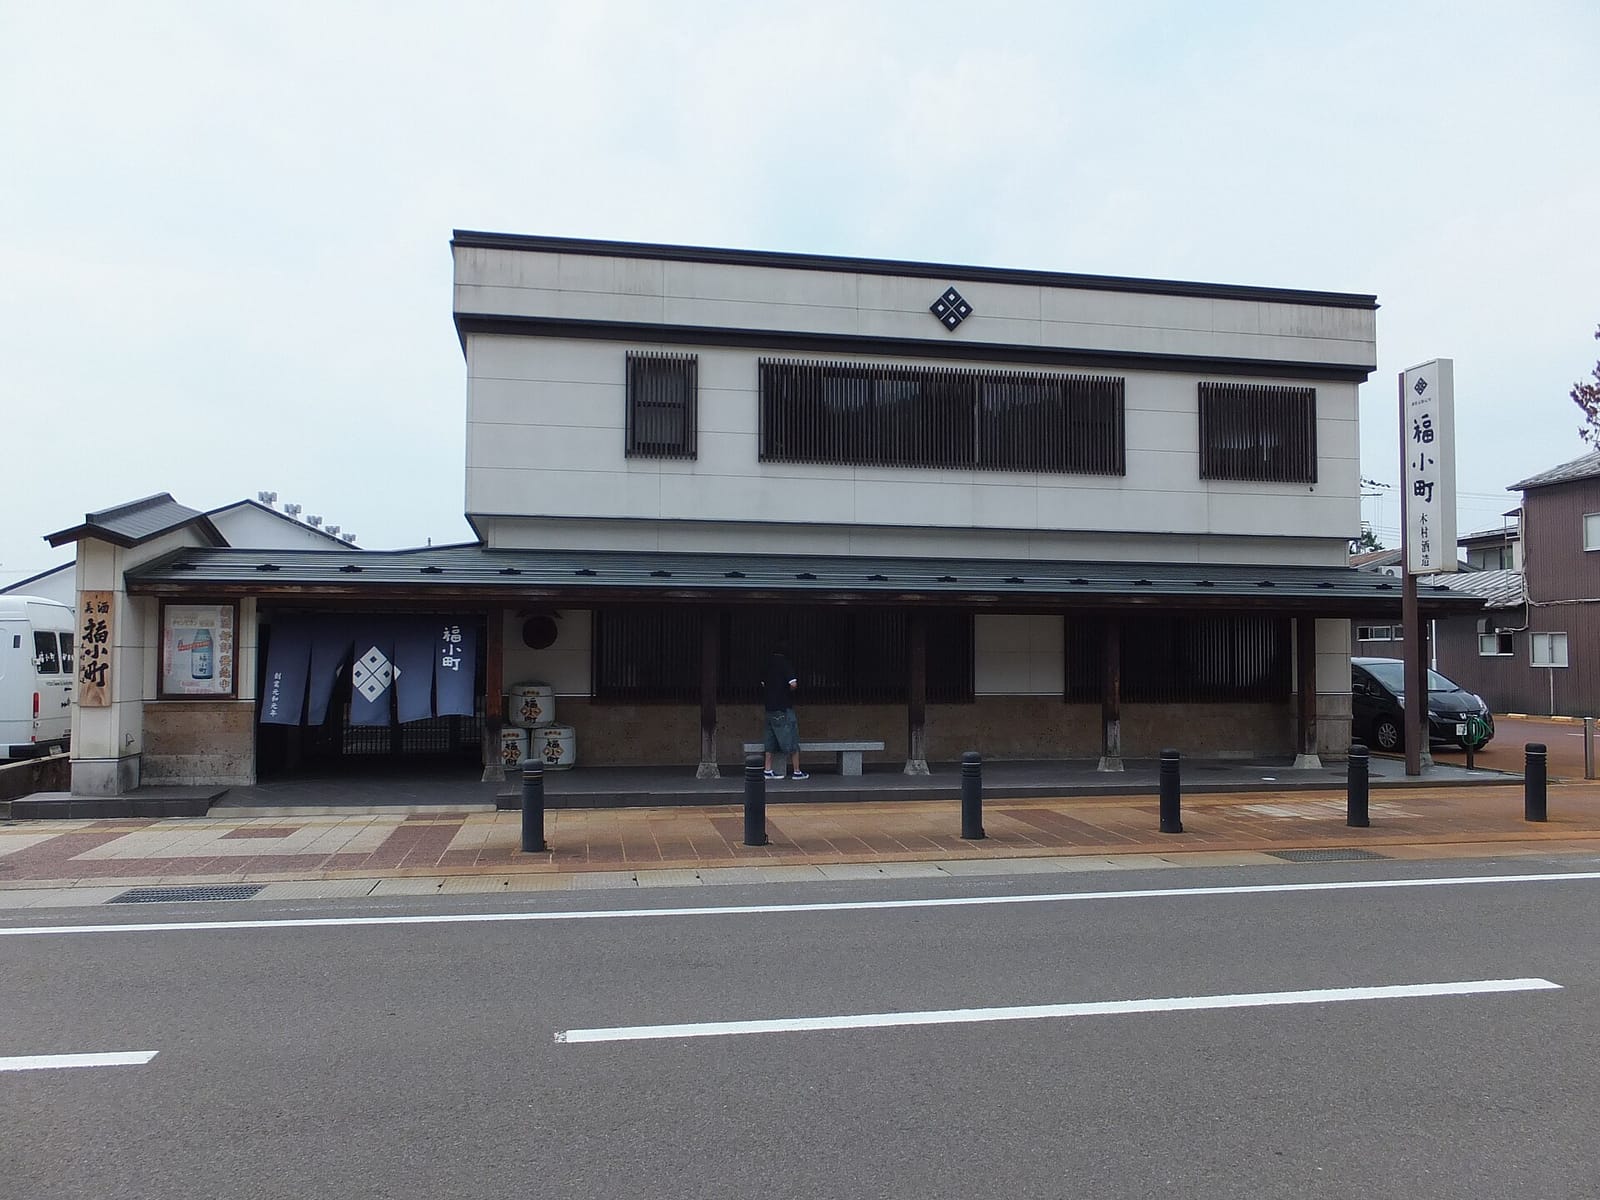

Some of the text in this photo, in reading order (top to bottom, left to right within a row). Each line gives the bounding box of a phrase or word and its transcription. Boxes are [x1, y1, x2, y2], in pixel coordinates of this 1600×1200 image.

[1412, 413, 1434, 503] 福小町
[1419, 512, 1430, 567] 木村酒造
[442, 625, 462, 671] 福小町
